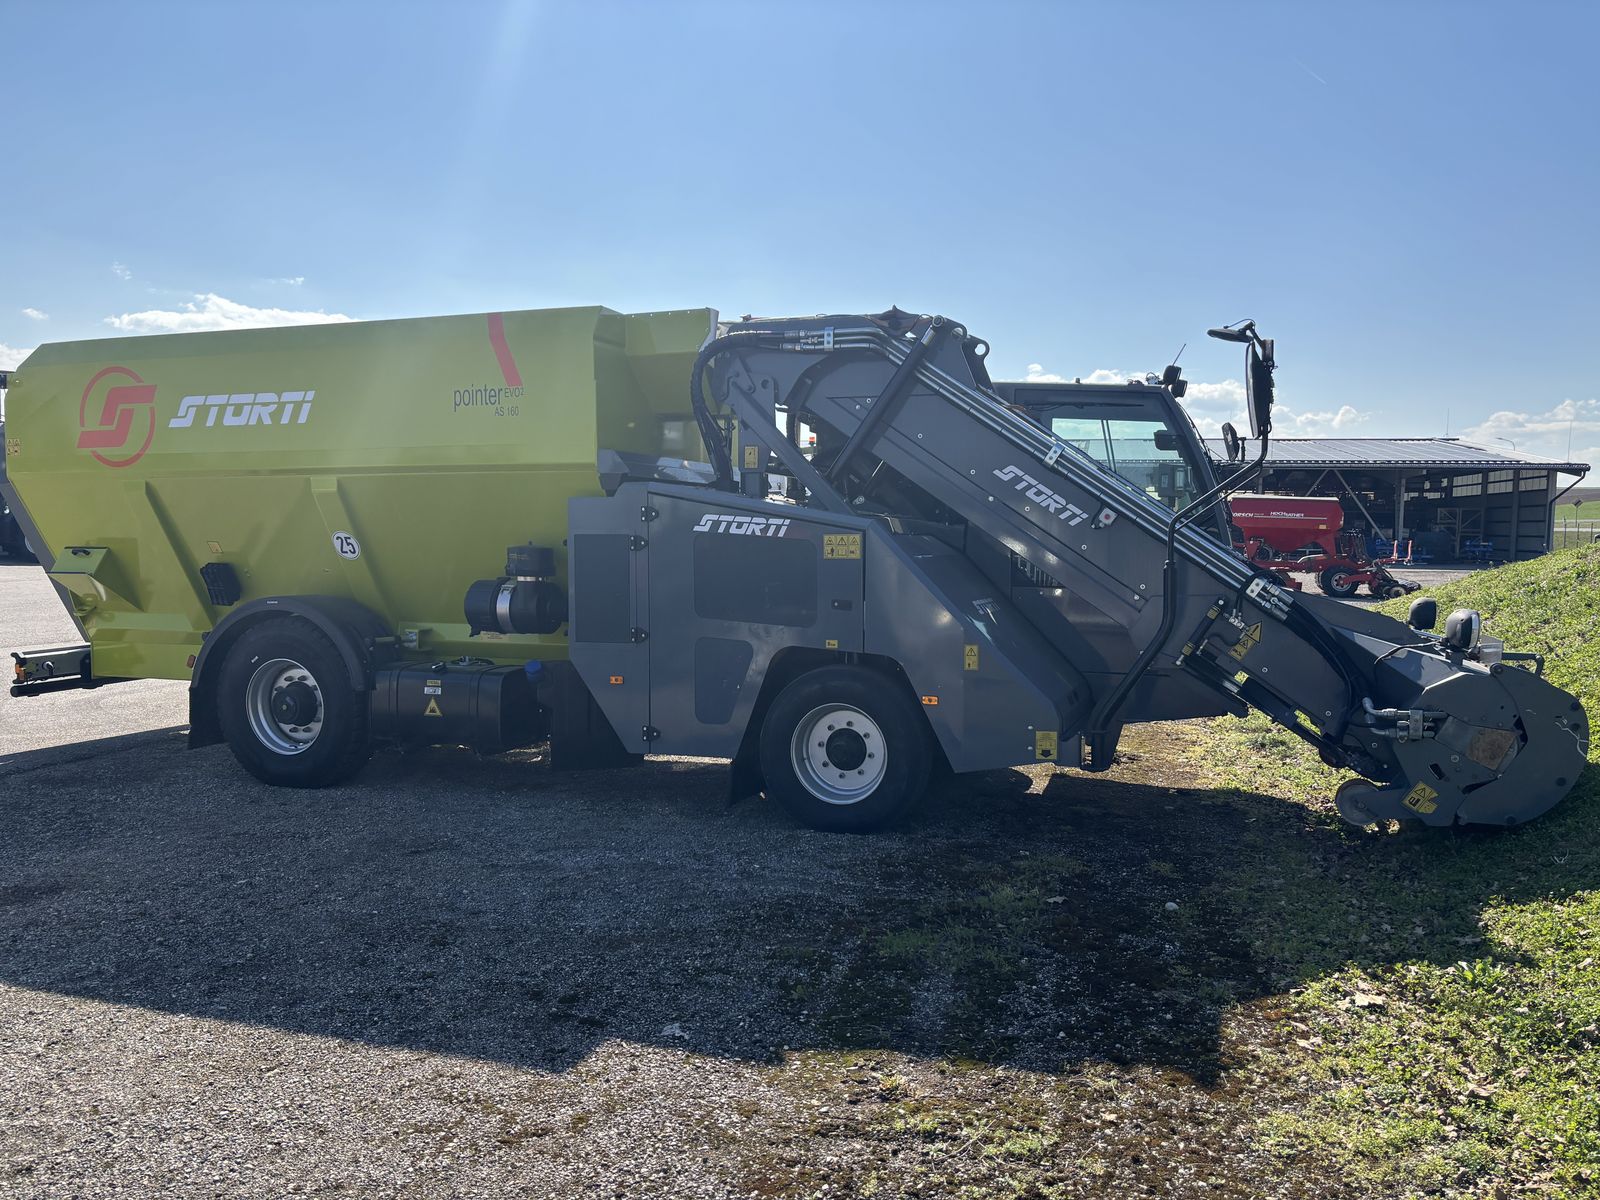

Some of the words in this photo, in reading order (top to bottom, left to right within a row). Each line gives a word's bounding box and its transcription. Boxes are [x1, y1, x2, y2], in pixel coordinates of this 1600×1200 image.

[168, 390, 316, 428] STORTI
[453, 383, 503, 412] pointer
[494, 406, 505, 416] AS
[507, 406, 519, 416] 160
[992, 465, 1089, 527] STORTI
[693, 514, 791, 538] STORTI
[335, 536, 357, 554] 25
